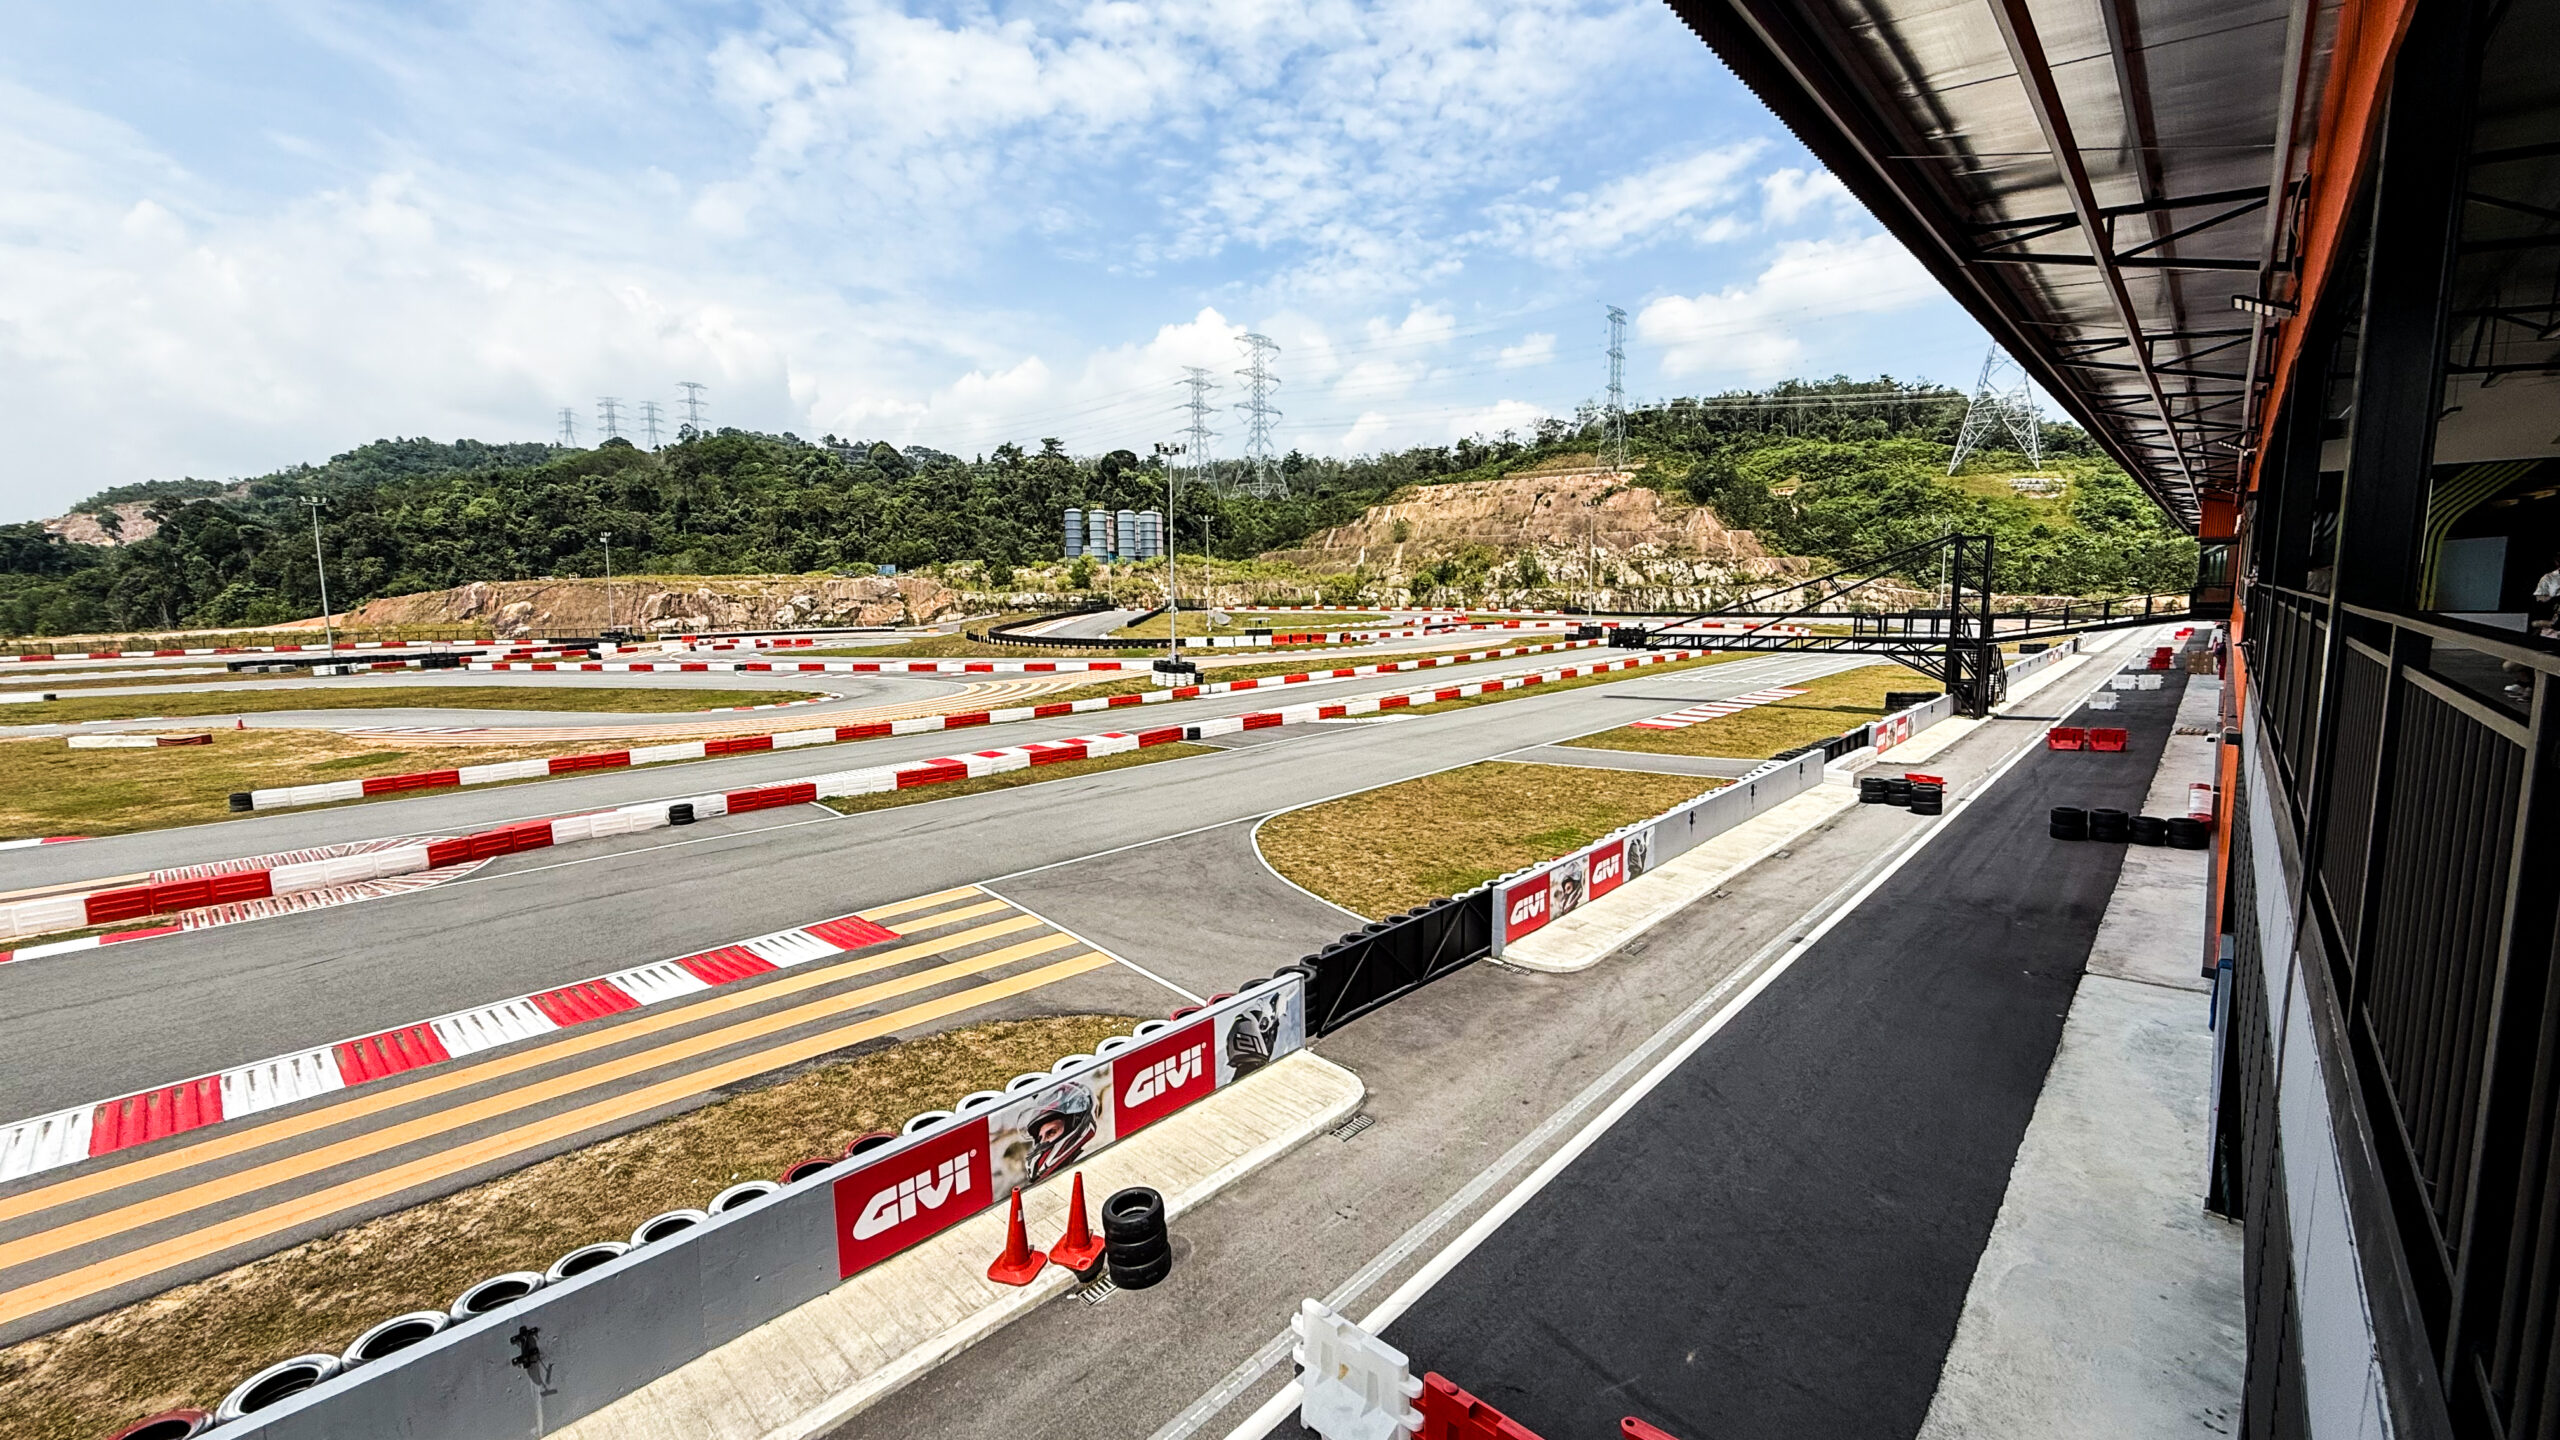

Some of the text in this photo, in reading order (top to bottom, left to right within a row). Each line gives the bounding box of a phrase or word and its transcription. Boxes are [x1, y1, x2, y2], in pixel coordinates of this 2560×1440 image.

[1510, 889, 1545, 926] GIVI
[1124, 1044, 1202, 1108] GIVI
[853, 1152, 971, 1240] GIVI
